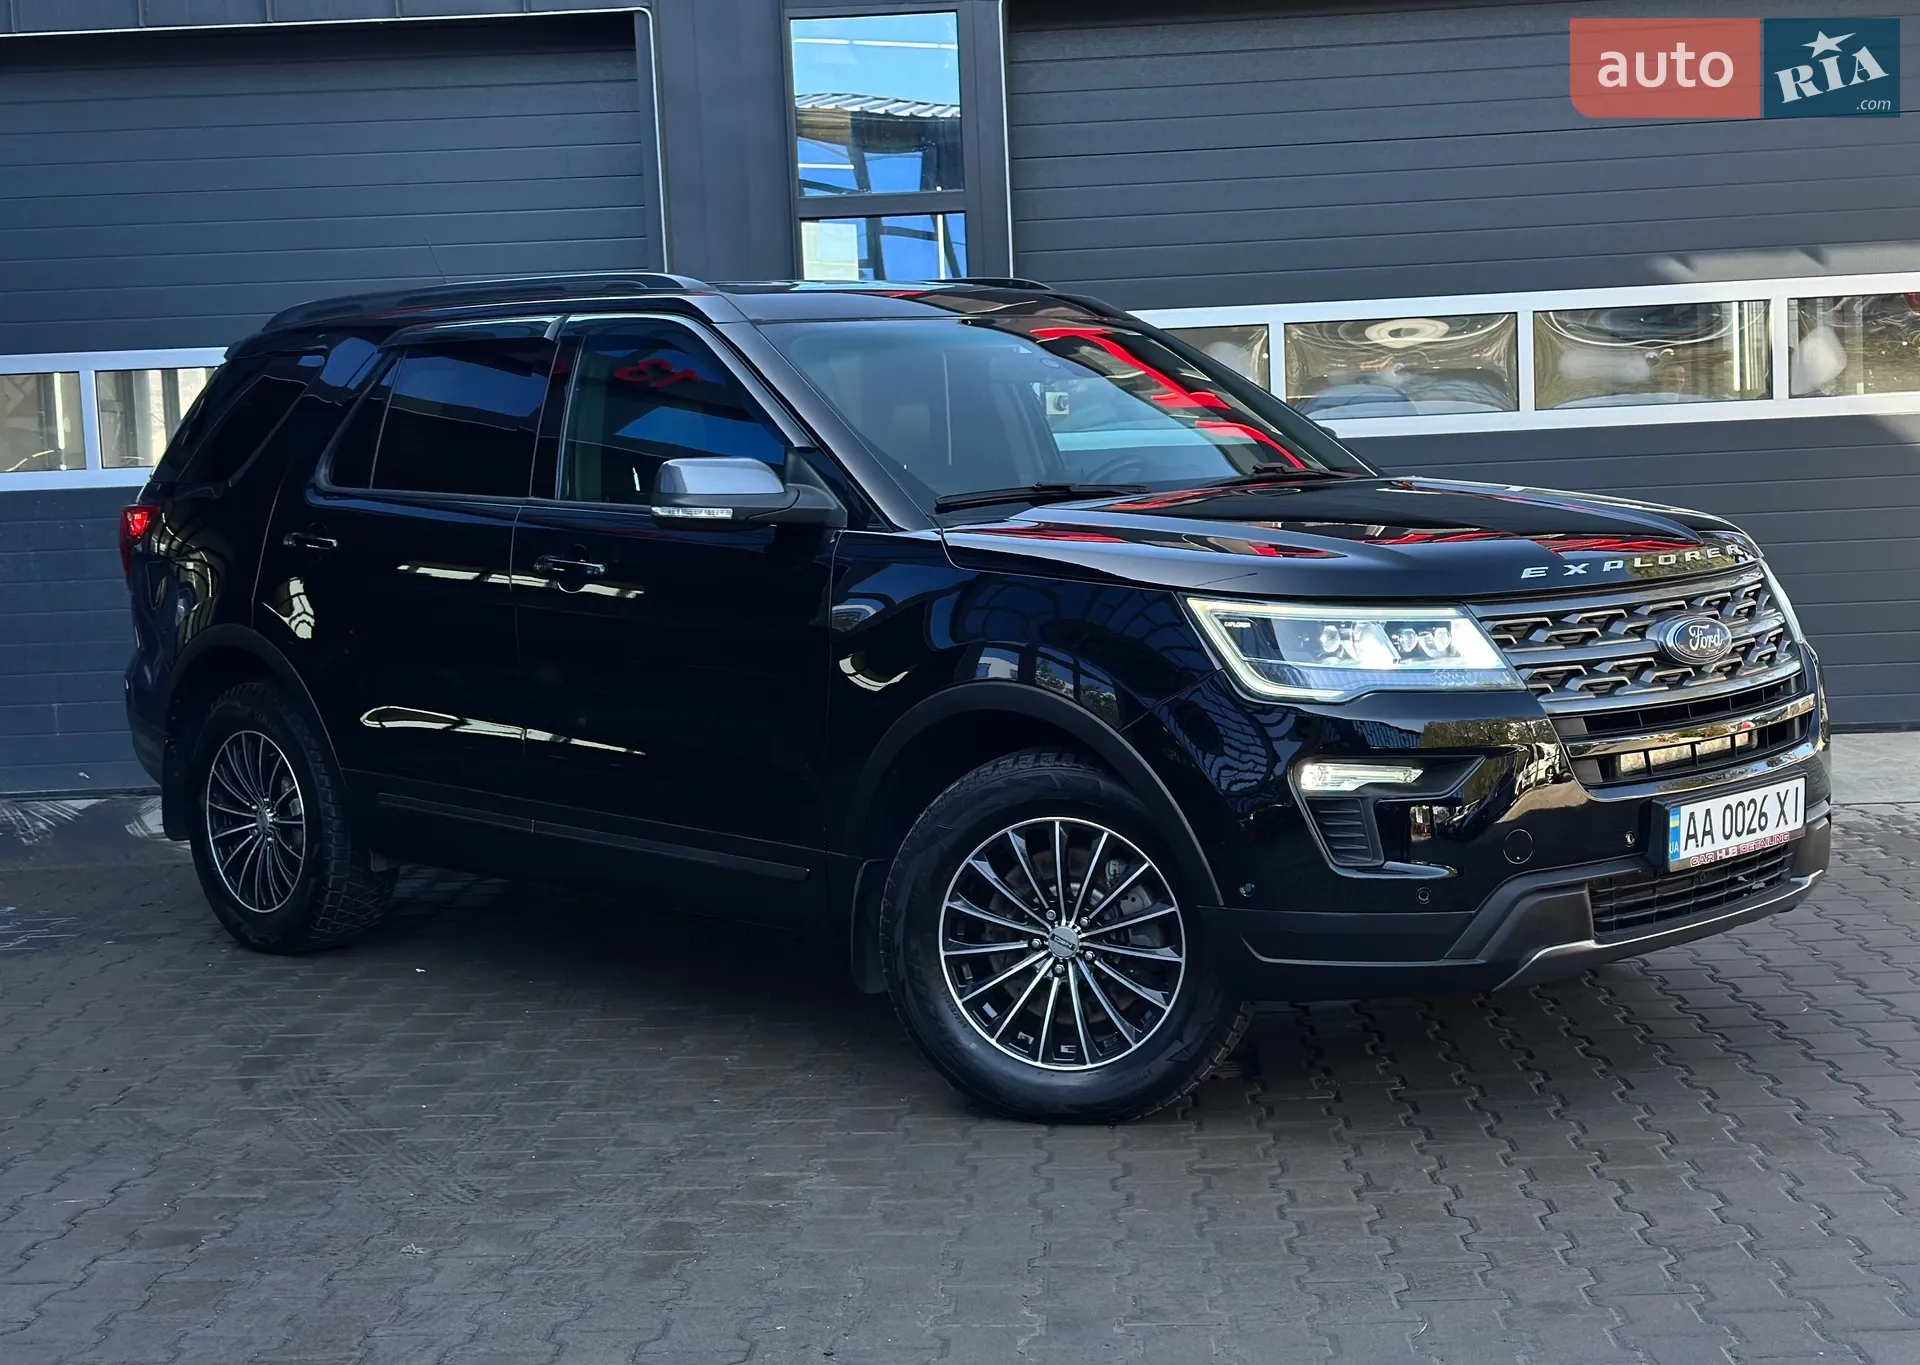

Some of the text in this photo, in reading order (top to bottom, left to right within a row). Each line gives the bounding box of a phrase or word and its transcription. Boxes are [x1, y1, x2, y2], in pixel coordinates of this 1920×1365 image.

[1521, 544, 1744, 578] EXPLORER
[1689, 625, 1723, 650] Ford
[1684, 808, 1715, 851] AA
[1722, 795, 1768, 841] 0026
[1669, 840, 1680, 854] UA
[1690, 853, 1715, 868] CAR
[1740, 832, 1790, 854] DETAILING
